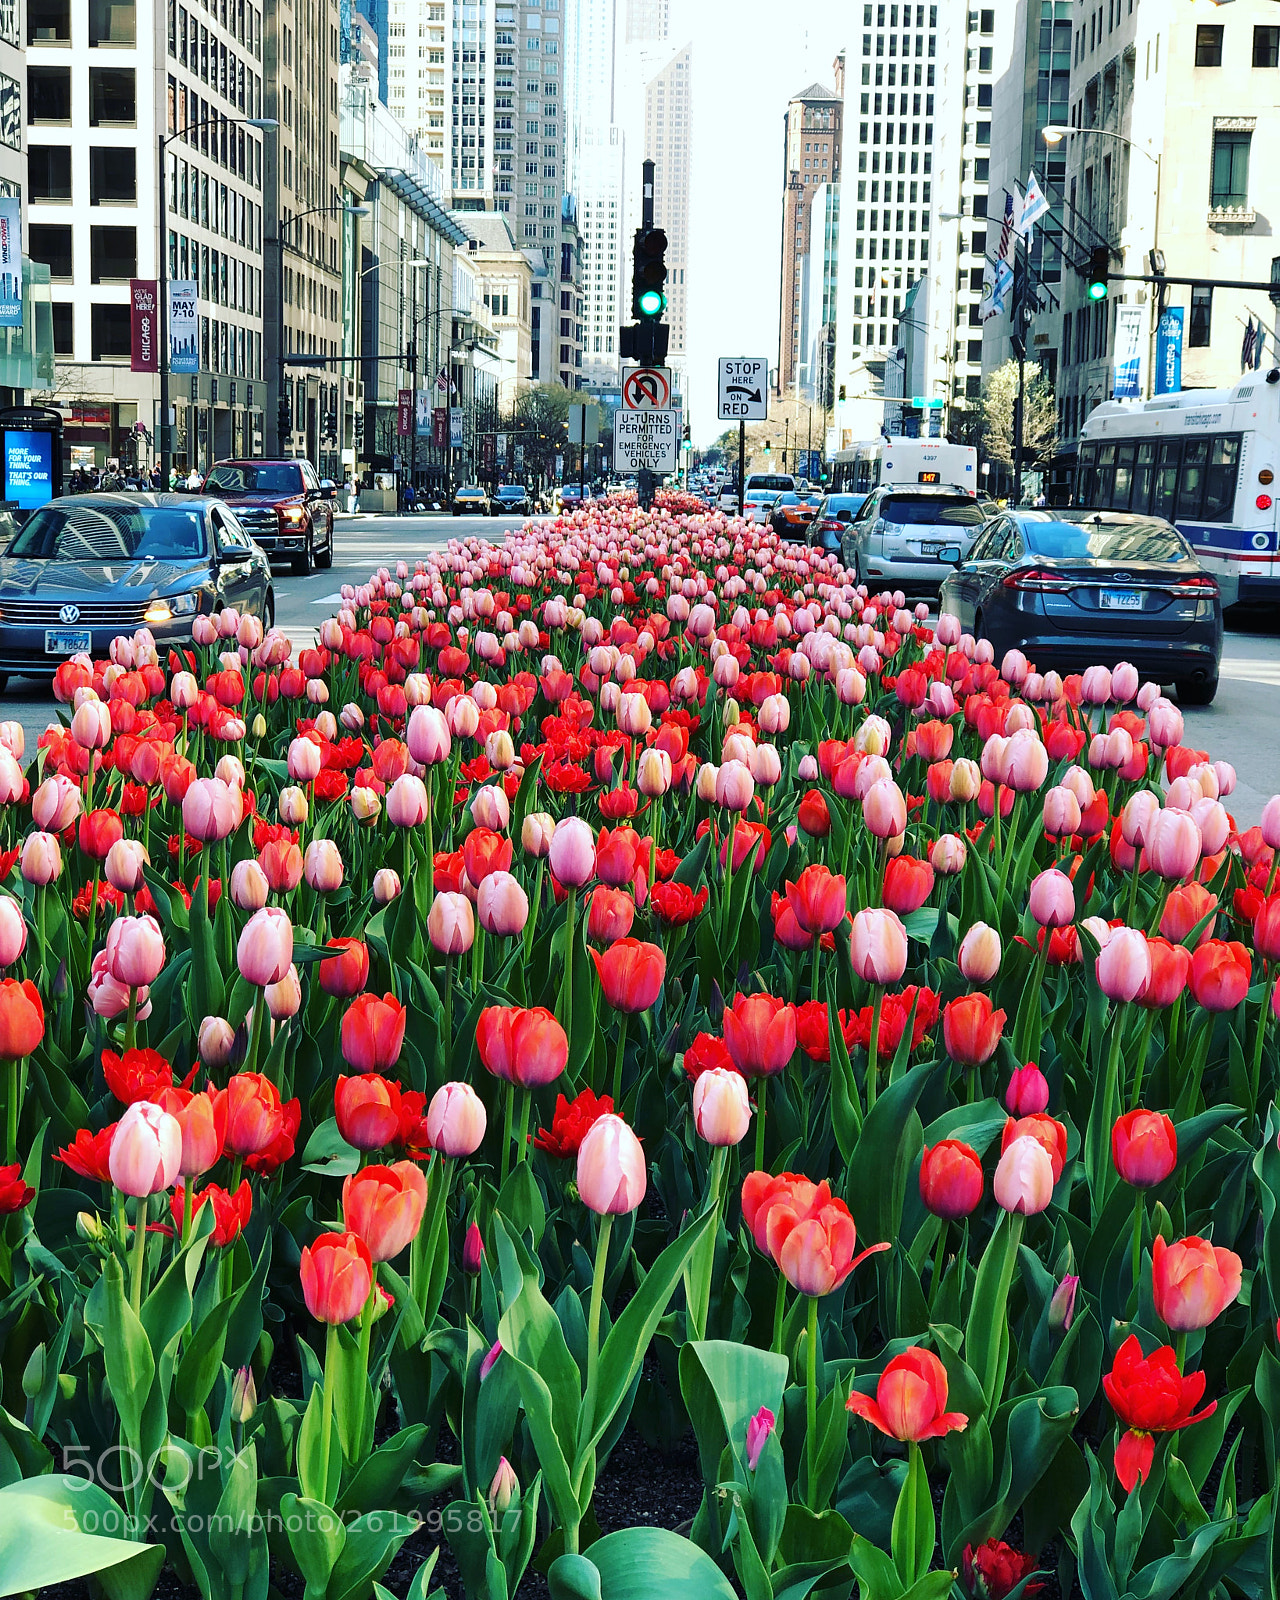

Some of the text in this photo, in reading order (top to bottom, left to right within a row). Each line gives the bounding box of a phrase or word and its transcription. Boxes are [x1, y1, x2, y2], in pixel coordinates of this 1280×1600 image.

[136, 303, 155, 314] HERE!
[172, 301, 195, 310] MAY
[172, 310, 195, 318] 7-10
[141, 317, 151, 361] CHICAGO
[725, 362, 761, 375] STOP
[732, 376, 754, 384] HERE
[730, 393, 742, 401] ON
[722, 403, 749, 415] RED
[622, 413, 670, 424] U-TURNS
[619, 424, 672, 434] PERMITTED
[637, 434, 654, 442] FOR
[619, 442, 672, 450] EMERGENCY
[624, 450, 667, 458] VEHICLES
[23, 455, 42, 463] YOUR
[630, 458, 660, 468] ONLY
[9, 462, 31, 470] THING.
[9, 471, 48, 480] THAT'S OUR
[923, 473, 936, 482] 147
